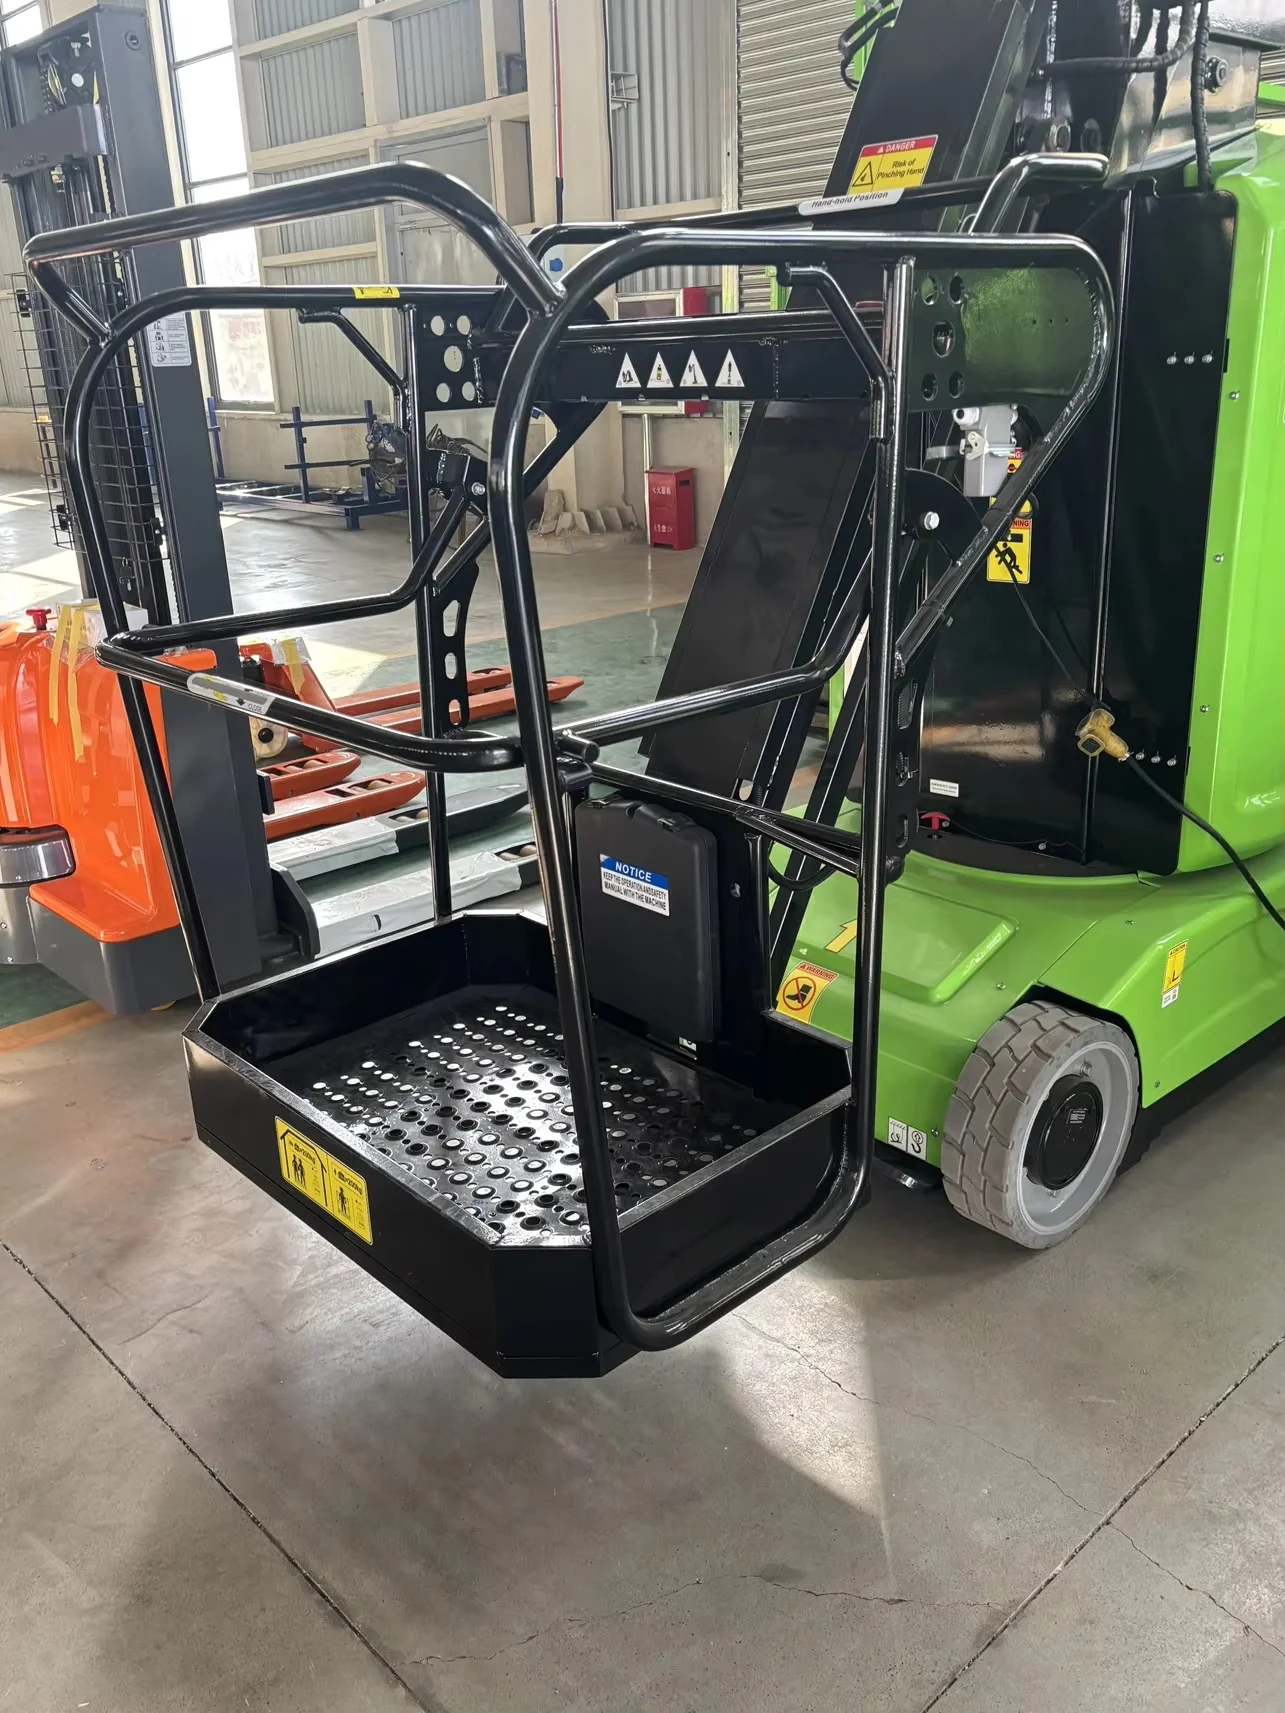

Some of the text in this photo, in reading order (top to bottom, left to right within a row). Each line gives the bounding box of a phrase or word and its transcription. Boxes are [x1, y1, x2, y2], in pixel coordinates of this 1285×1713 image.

[885, 141, 915, 152] DANGER
[892, 158, 916, 168] Risk of
[877, 167, 924, 179] Pinching Hand
[853, 192, 888, 202] Position
[615, 861, 652, 882] NOTICE
[603, 871, 613, 881] KEEP
[613, 874, 621, 885] THE
[621, 877, 643, 892] OPERATION
[604, 880, 667, 911] MANUAL WITH THE MACHINE
[806, 966, 835, 980] WARNING
